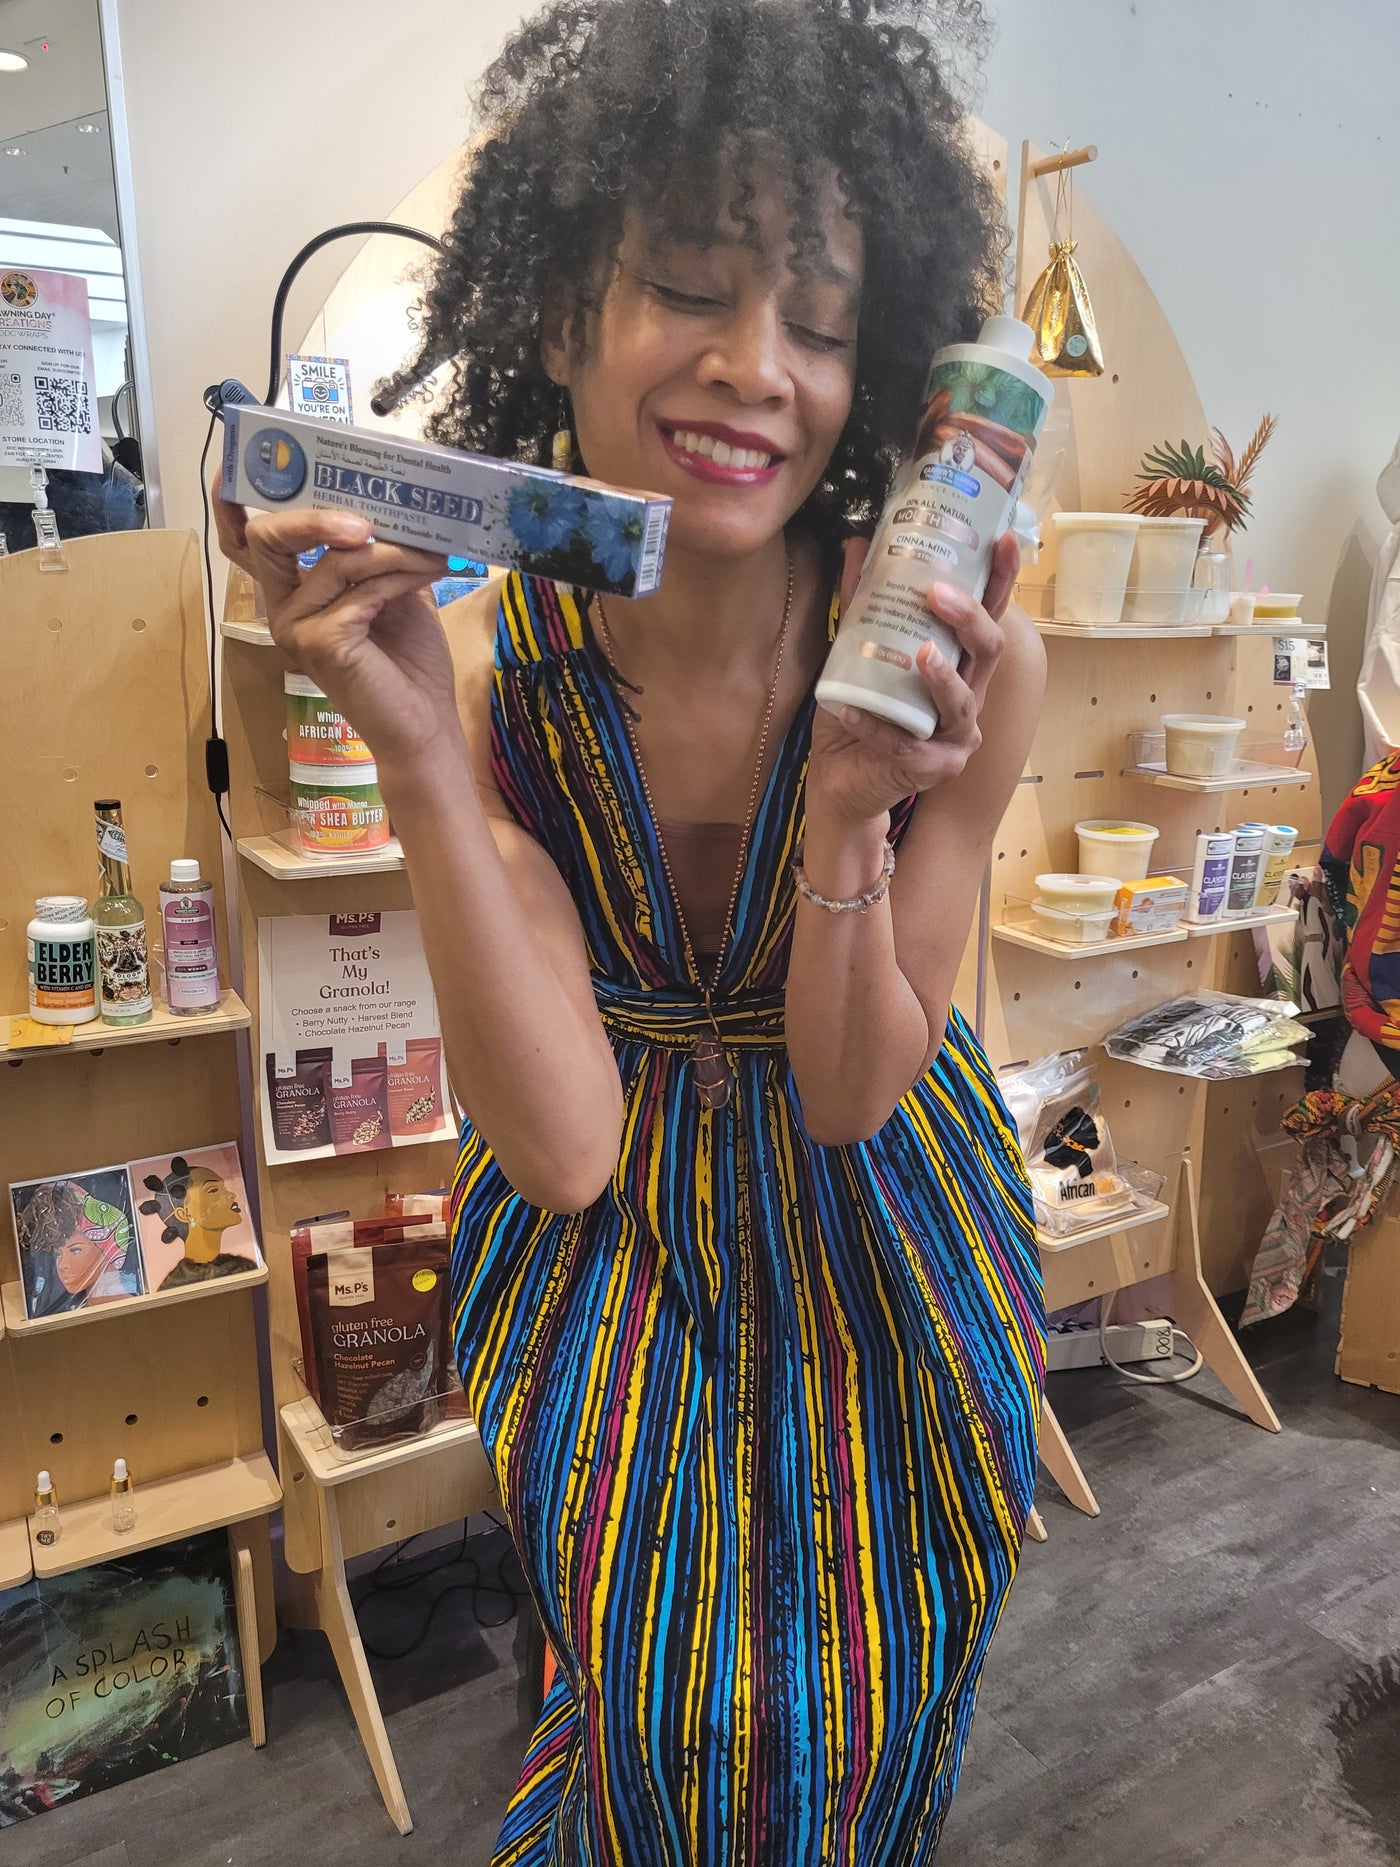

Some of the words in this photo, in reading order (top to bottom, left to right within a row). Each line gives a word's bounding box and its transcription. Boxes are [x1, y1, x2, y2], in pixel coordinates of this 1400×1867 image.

[13, 344, 56, 354] CONNECTED
[58, 348, 74, 356] WITH
[301, 364, 337, 379] SMILE
[298, 403, 331, 414] YOU'RE
[332, 405, 346, 415] ON
[28, 437, 65, 445] LOCATION
[316, 435, 348, 451] Nature's
[383, 450, 395, 461] for
[396, 454, 424, 468] Dental
[425, 460, 452, 475] Health
[316, 464, 403, 505] BLACK
[410, 485, 479, 523] SEED
[313, 490, 356, 508] HERBAL
[360, 501, 430, 525] TOOTHPASTE
[920, 499, 937, 509] ALL
[939, 503, 973, 528] NATURAL
[392, 522, 399, 530] &
[435, 532, 453, 543] Free
[896, 535, 953, 559] CINNA-MINT
[899, 625, 913, 636] Bad
[1277, 639, 1295, 651] $15
[299, 724, 343, 739] AFRICAN
[297, 796, 330, 810] Whipped
[320, 812, 348, 827] SHEA
[352, 808, 384, 826] BUTTER
[38, 941, 92, 963] ELDER
[329, 945, 380, 963] That's
[37, 960, 93, 984] BERRY
[342, 964, 368, 981] My
[319, 980, 390, 999] Granola!
[291, 1007, 323, 1017] Choose
[333, 1003, 357, 1012] snack
[359, 1002, 377, 1011] from
[379, 1001, 392, 1009] our
[394, 999, 417, 1009] range
[302, 1018, 325, 1028] Berry
[327, 1016, 348, 1025] Nutty
[357, 1012, 389, 1022] Harvest
[390, 1009, 413, 1020] Blend
[304, 1025, 346, 1038] Chocolate
[348, 1022, 384, 1034] Hazelnut
[385, 1020, 410, 1031] Pecan
[387, 1075, 430, 1087] GRANOLA
[275, 1087, 321, 1099] GRANOLA
[333, 1097, 377, 1109] GRANOLA
[1059, 1178, 1096, 1202] African
[331, 1320, 369, 1334] gluten
[370, 1317, 394, 1329] free
[333, 1323, 426, 1348] GRANOLA
[333, 1353, 374, 1362] Chocolate
[335, 1361, 369, 1370] Hazelnut
[370, 1359, 395, 1368] Pecan
[51, 1664, 69, 1687] A
[75, 1615, 190, 1677] SPLASH
[45, 1691, 81, 1719] OF
[94, 1648, 187, 1698] COLOR
